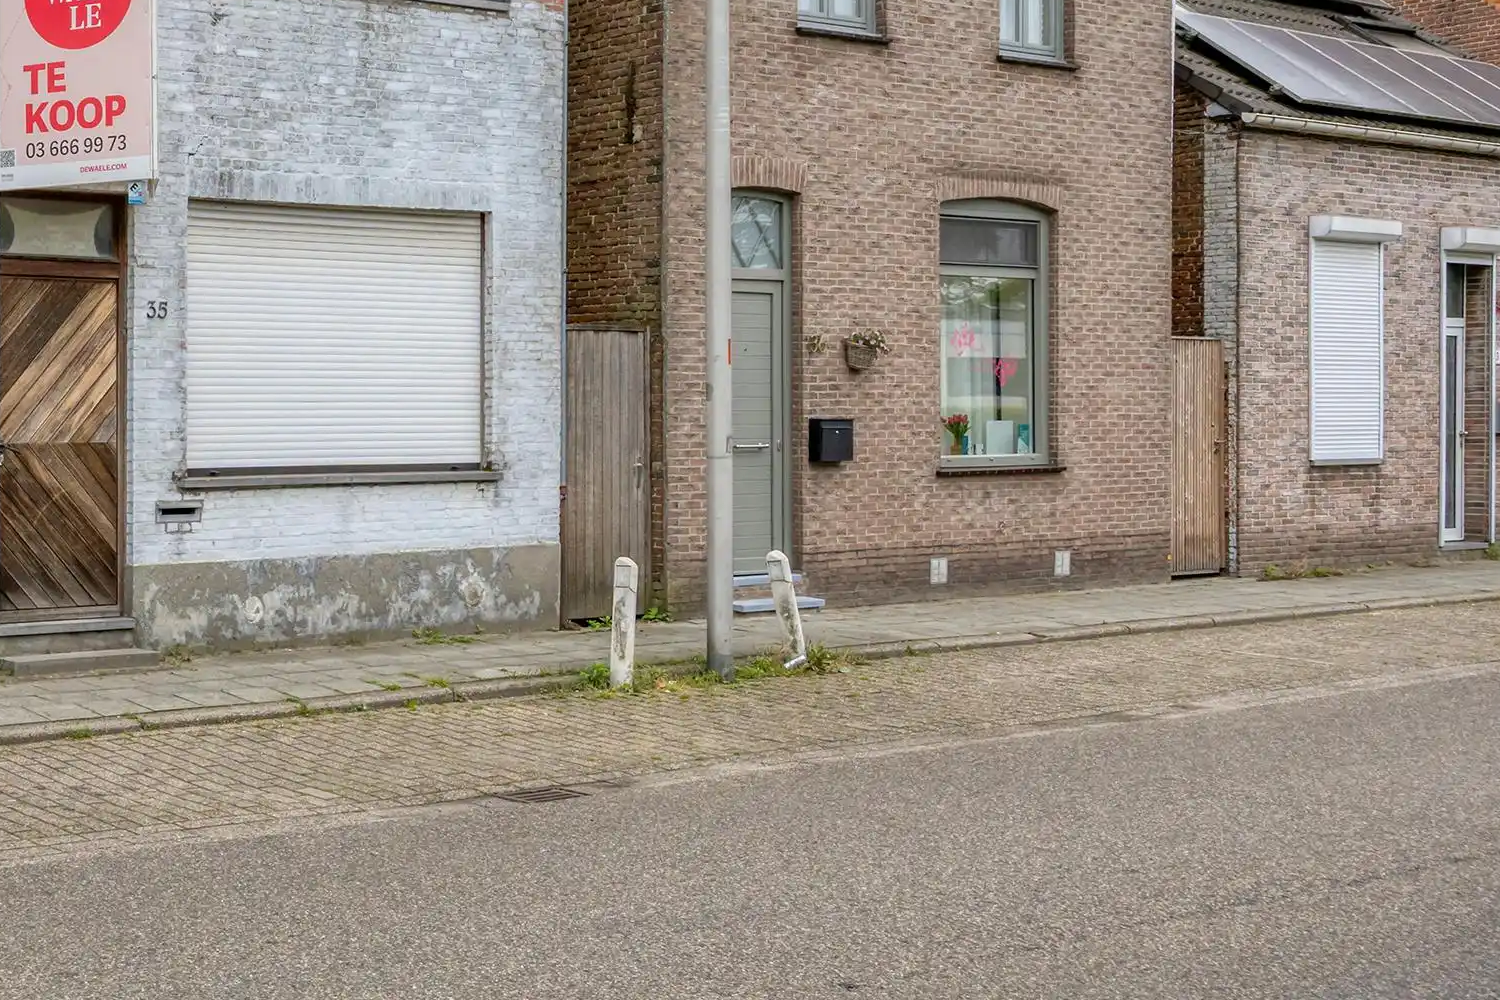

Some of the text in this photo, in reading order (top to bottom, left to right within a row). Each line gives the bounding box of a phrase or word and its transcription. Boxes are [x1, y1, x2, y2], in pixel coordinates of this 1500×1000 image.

[69, 3, 101, 30] LE
[23, 61, 66, 94] TE
[25, 95, 126, 133] KOOP
[26, 135, 127, 158] 03 666 99 73
[80, 163, 127, 173] DEWAELE.COM
[146, 300, 168, 320] 35
